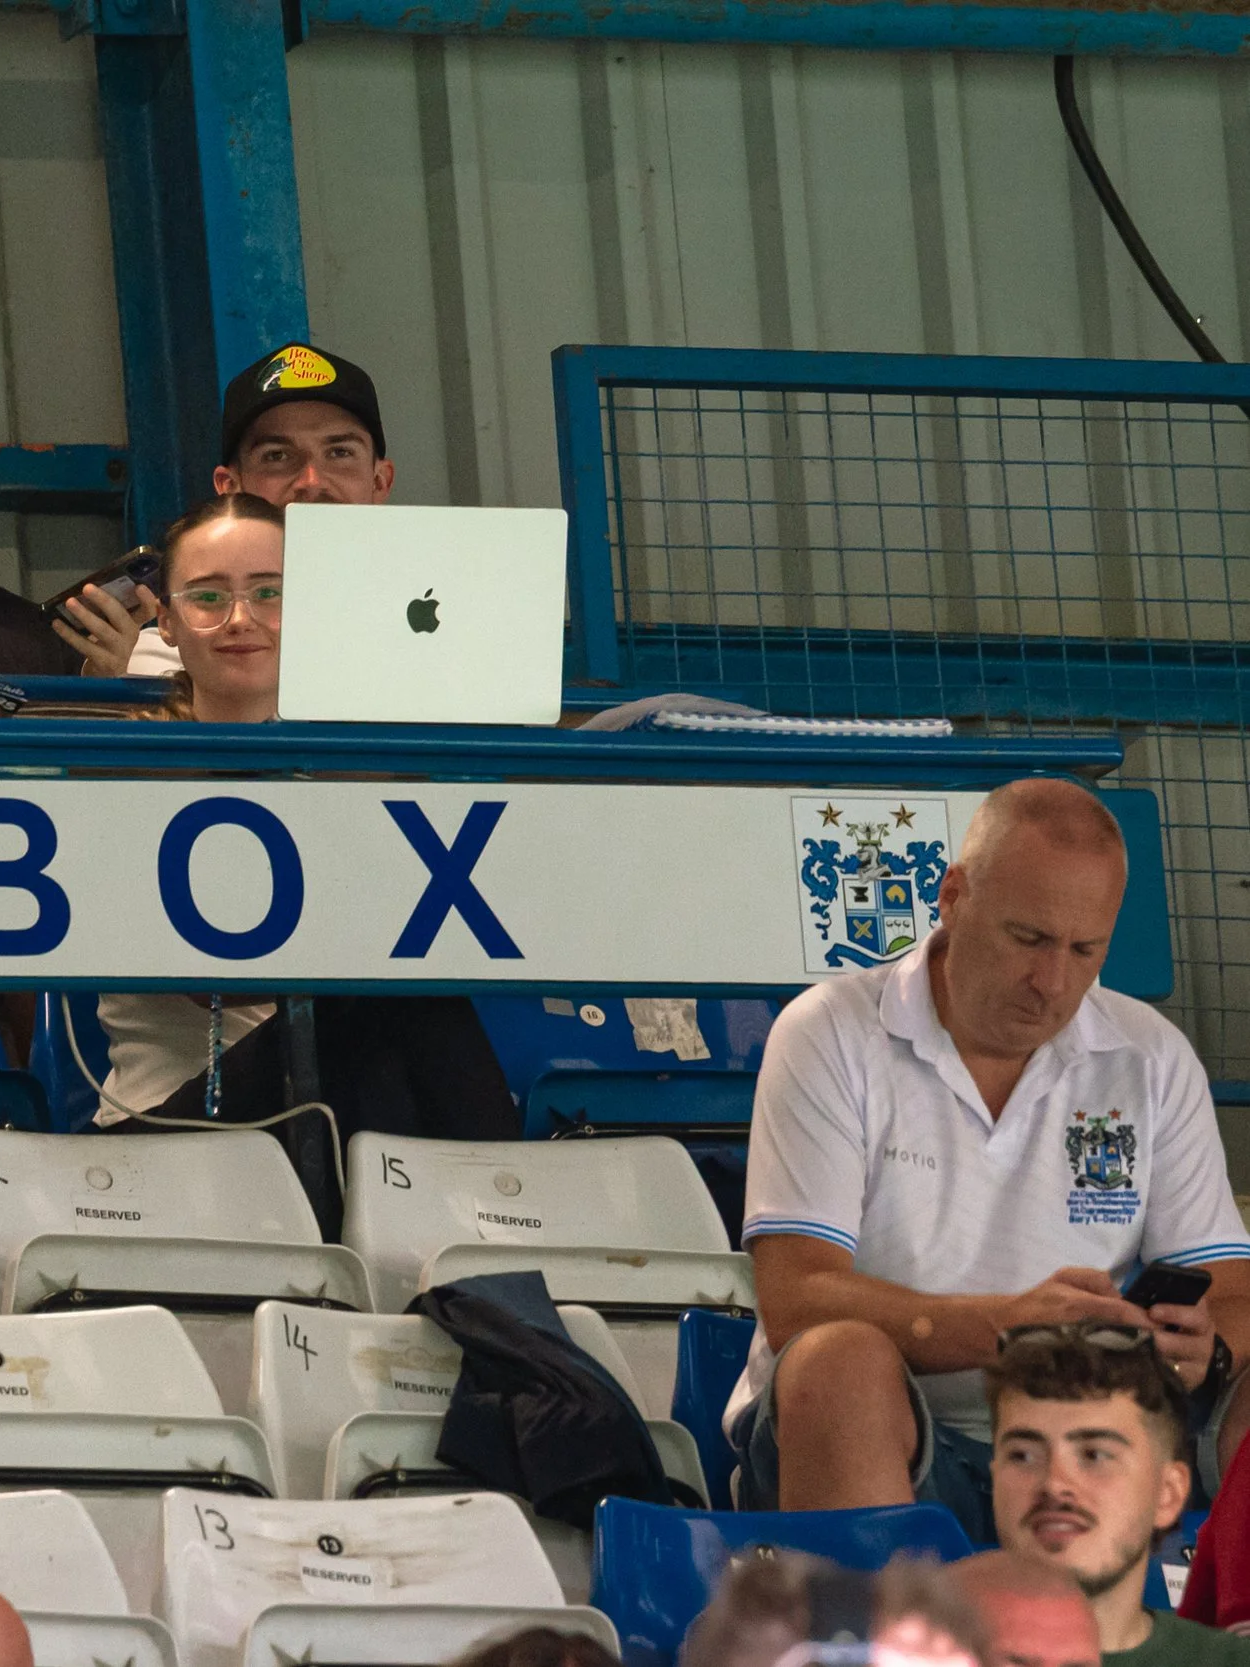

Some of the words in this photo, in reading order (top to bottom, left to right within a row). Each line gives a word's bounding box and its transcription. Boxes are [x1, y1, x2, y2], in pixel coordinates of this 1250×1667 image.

[289, 348, 321, 361] Bass
[291, 359, 315, 370] Pro
[586, 1011, 599, 1020] 16
[382, 1153, 411, 1189] 15
[75, 1206, 142, 1222] RESERVED
[477, 1211, 543, 1229] RESERVED
[283, 1314, 318, 1371] 14
[394, 1381, 452, 1397] RESERVE
[195, 1504, 235, 1550] 13
[302, 1565, 372, 1586] RESERVED
